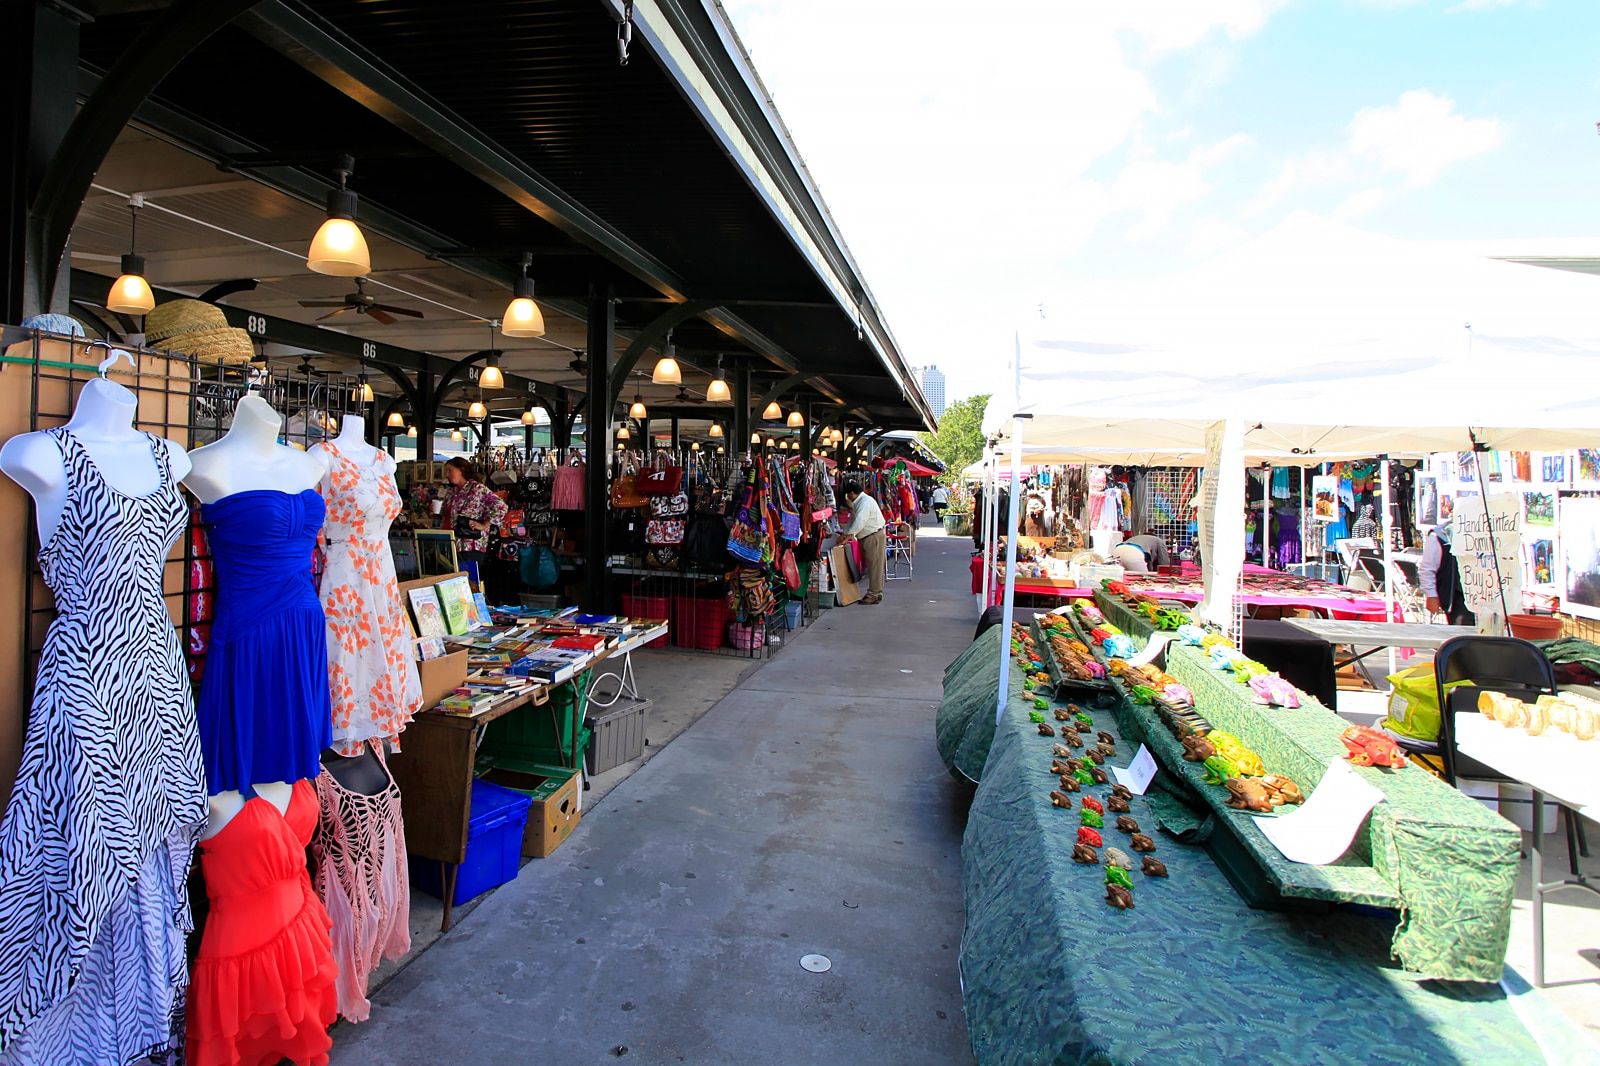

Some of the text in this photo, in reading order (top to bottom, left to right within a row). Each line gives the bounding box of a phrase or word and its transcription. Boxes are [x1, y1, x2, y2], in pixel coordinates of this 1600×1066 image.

[247, 315, 266, 335] 88
[363, 342, 377, 358] 86
[469, 367, 479, 381] 84
[528, 381, 536, 393] 82
[1456, 513, 1481, 534] Hand
[1463, 565, 1484, 595] Buy
[1485, 568, 1494, 588] 3
